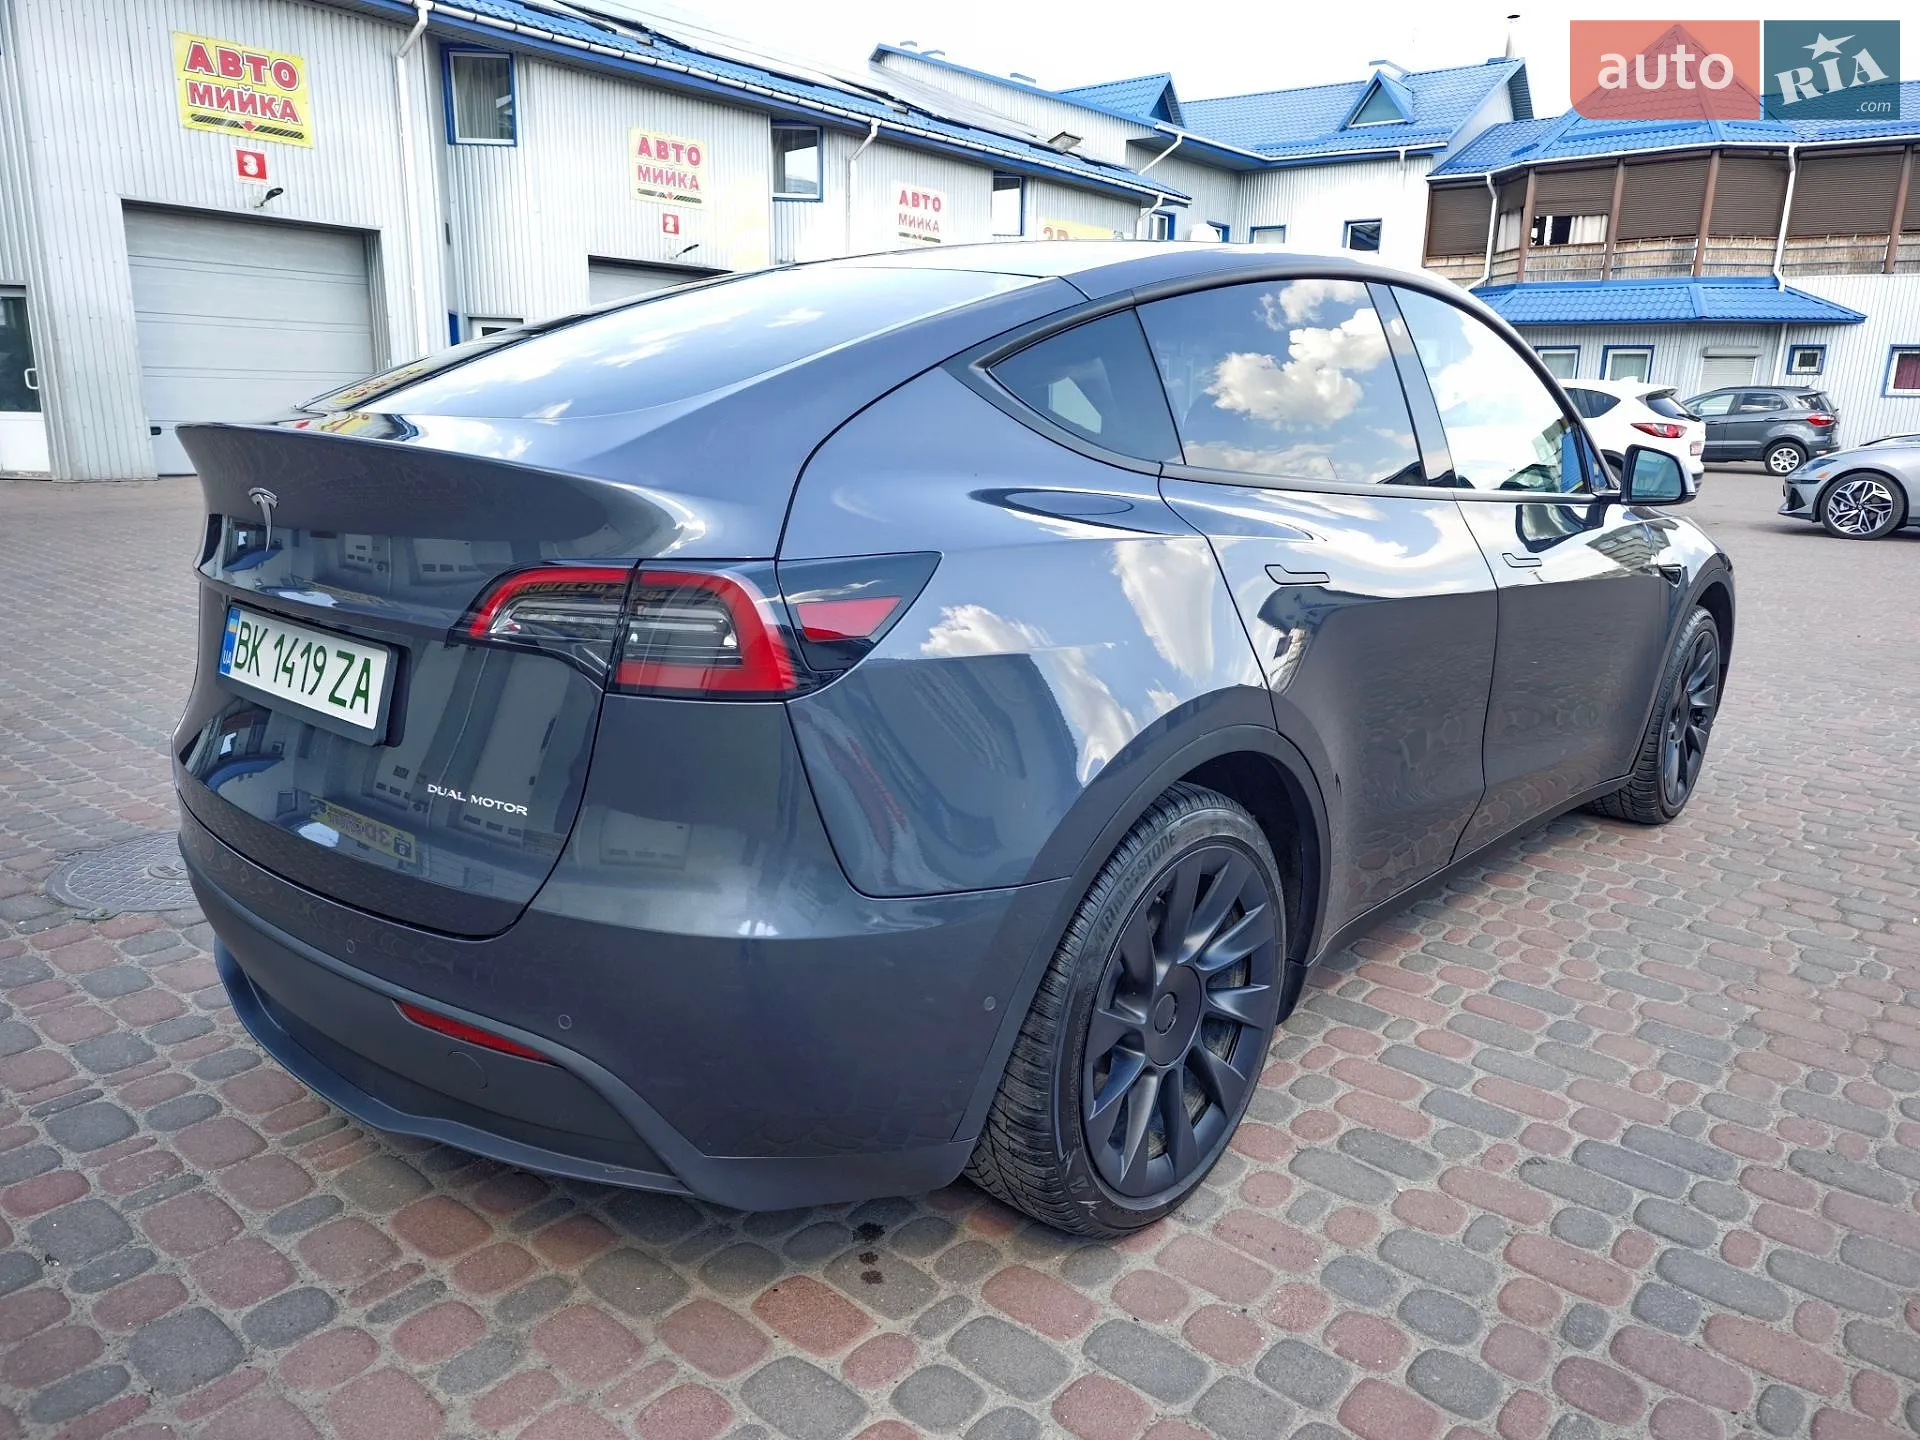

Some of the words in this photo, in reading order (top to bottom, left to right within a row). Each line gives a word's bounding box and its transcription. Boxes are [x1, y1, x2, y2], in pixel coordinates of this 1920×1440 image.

[185, 41, 299, 91] АВТО
[187, 80, 302, 125] МИЙКА
[243, 154, 259, 176] 3
[637, 135, 702, 167] АВТО
[636, 163, 700, 192] МИЙКА
[898, 189, 942, 212] АВТО
[221, 649, 232, 665] UA
[234, 621, 269, 677] BK
[273, 633, 327, 696] 1419
[328, 649, 371, 714] ZA
[427, 783, 467, 802] DUAL
[470, 794, 528, 816] MOTOR
